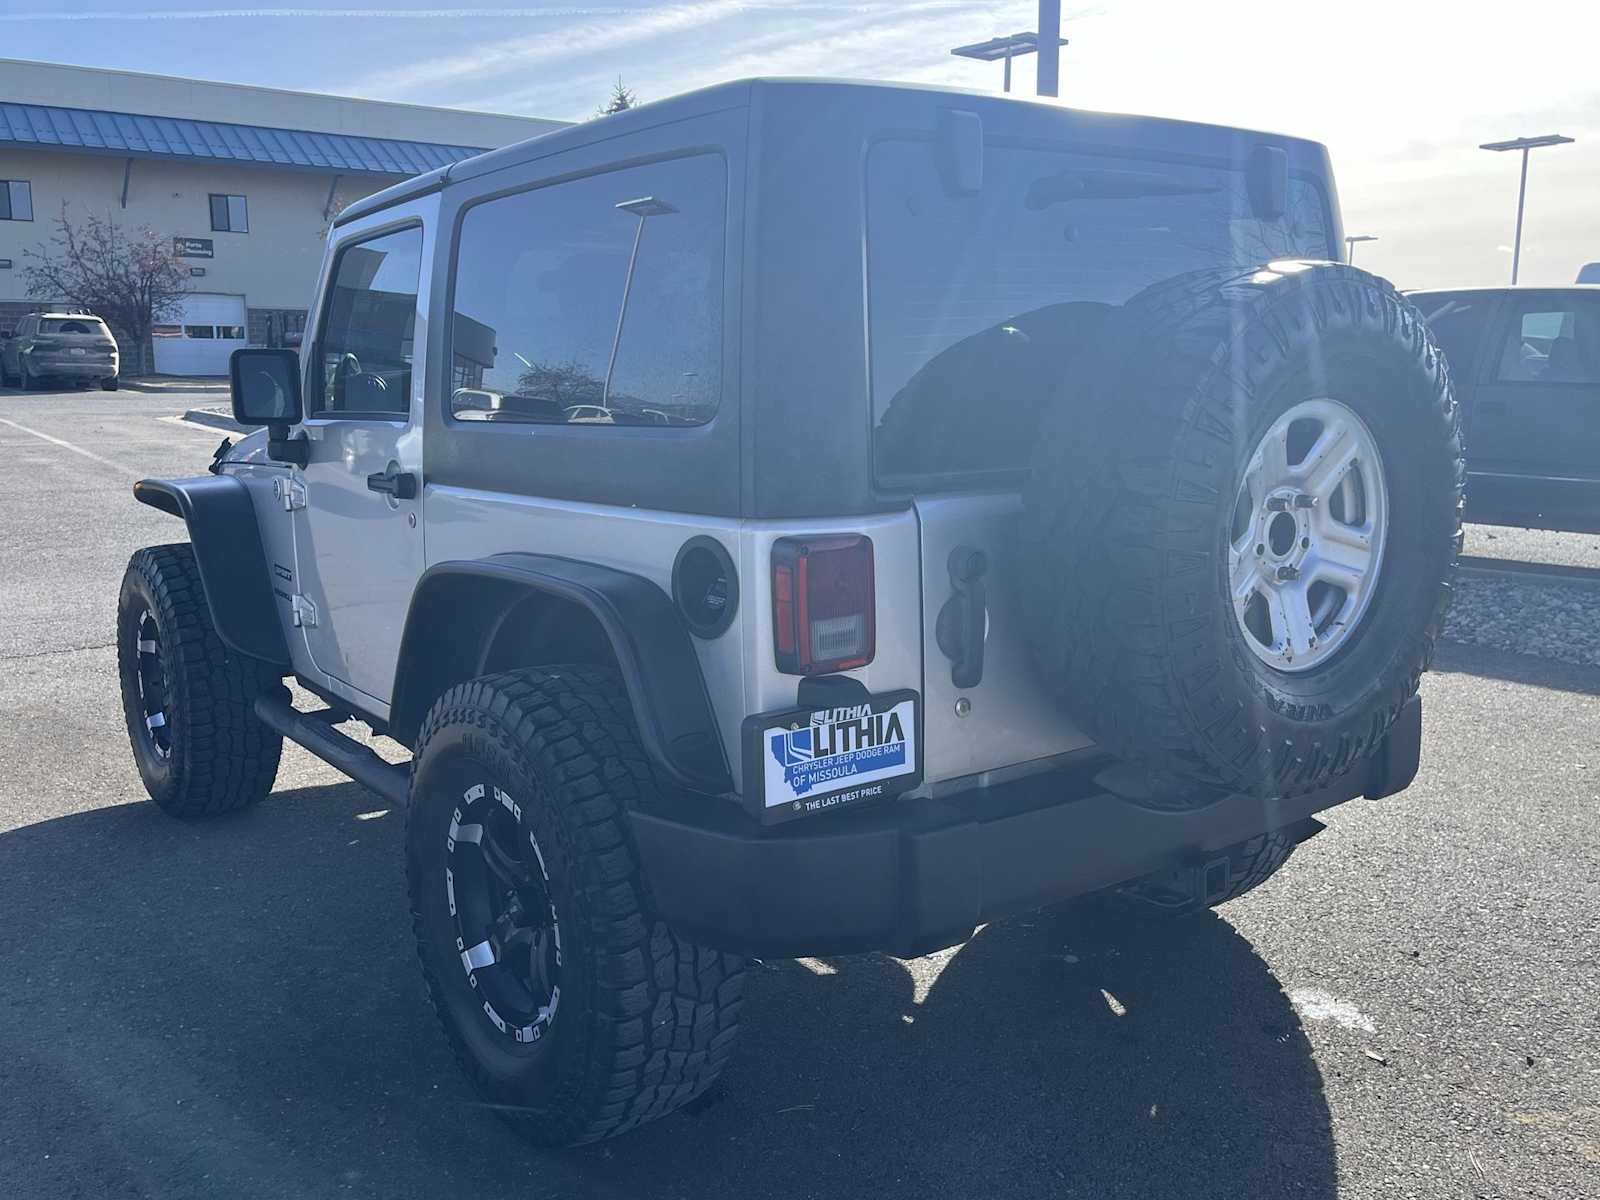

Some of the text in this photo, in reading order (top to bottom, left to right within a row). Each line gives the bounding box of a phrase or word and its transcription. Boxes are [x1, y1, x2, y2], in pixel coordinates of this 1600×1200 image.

[824, 703, 872, 723] LITHIA
[813, 712, 905, 759] LITHIA
[792, 745, 901, 775] CHRYSLER JEEP DODGE RAM
[793, 764, 858, 788] OF MISSOULA
[805, 786, 882, 812] THE LAST BEST PRICE
